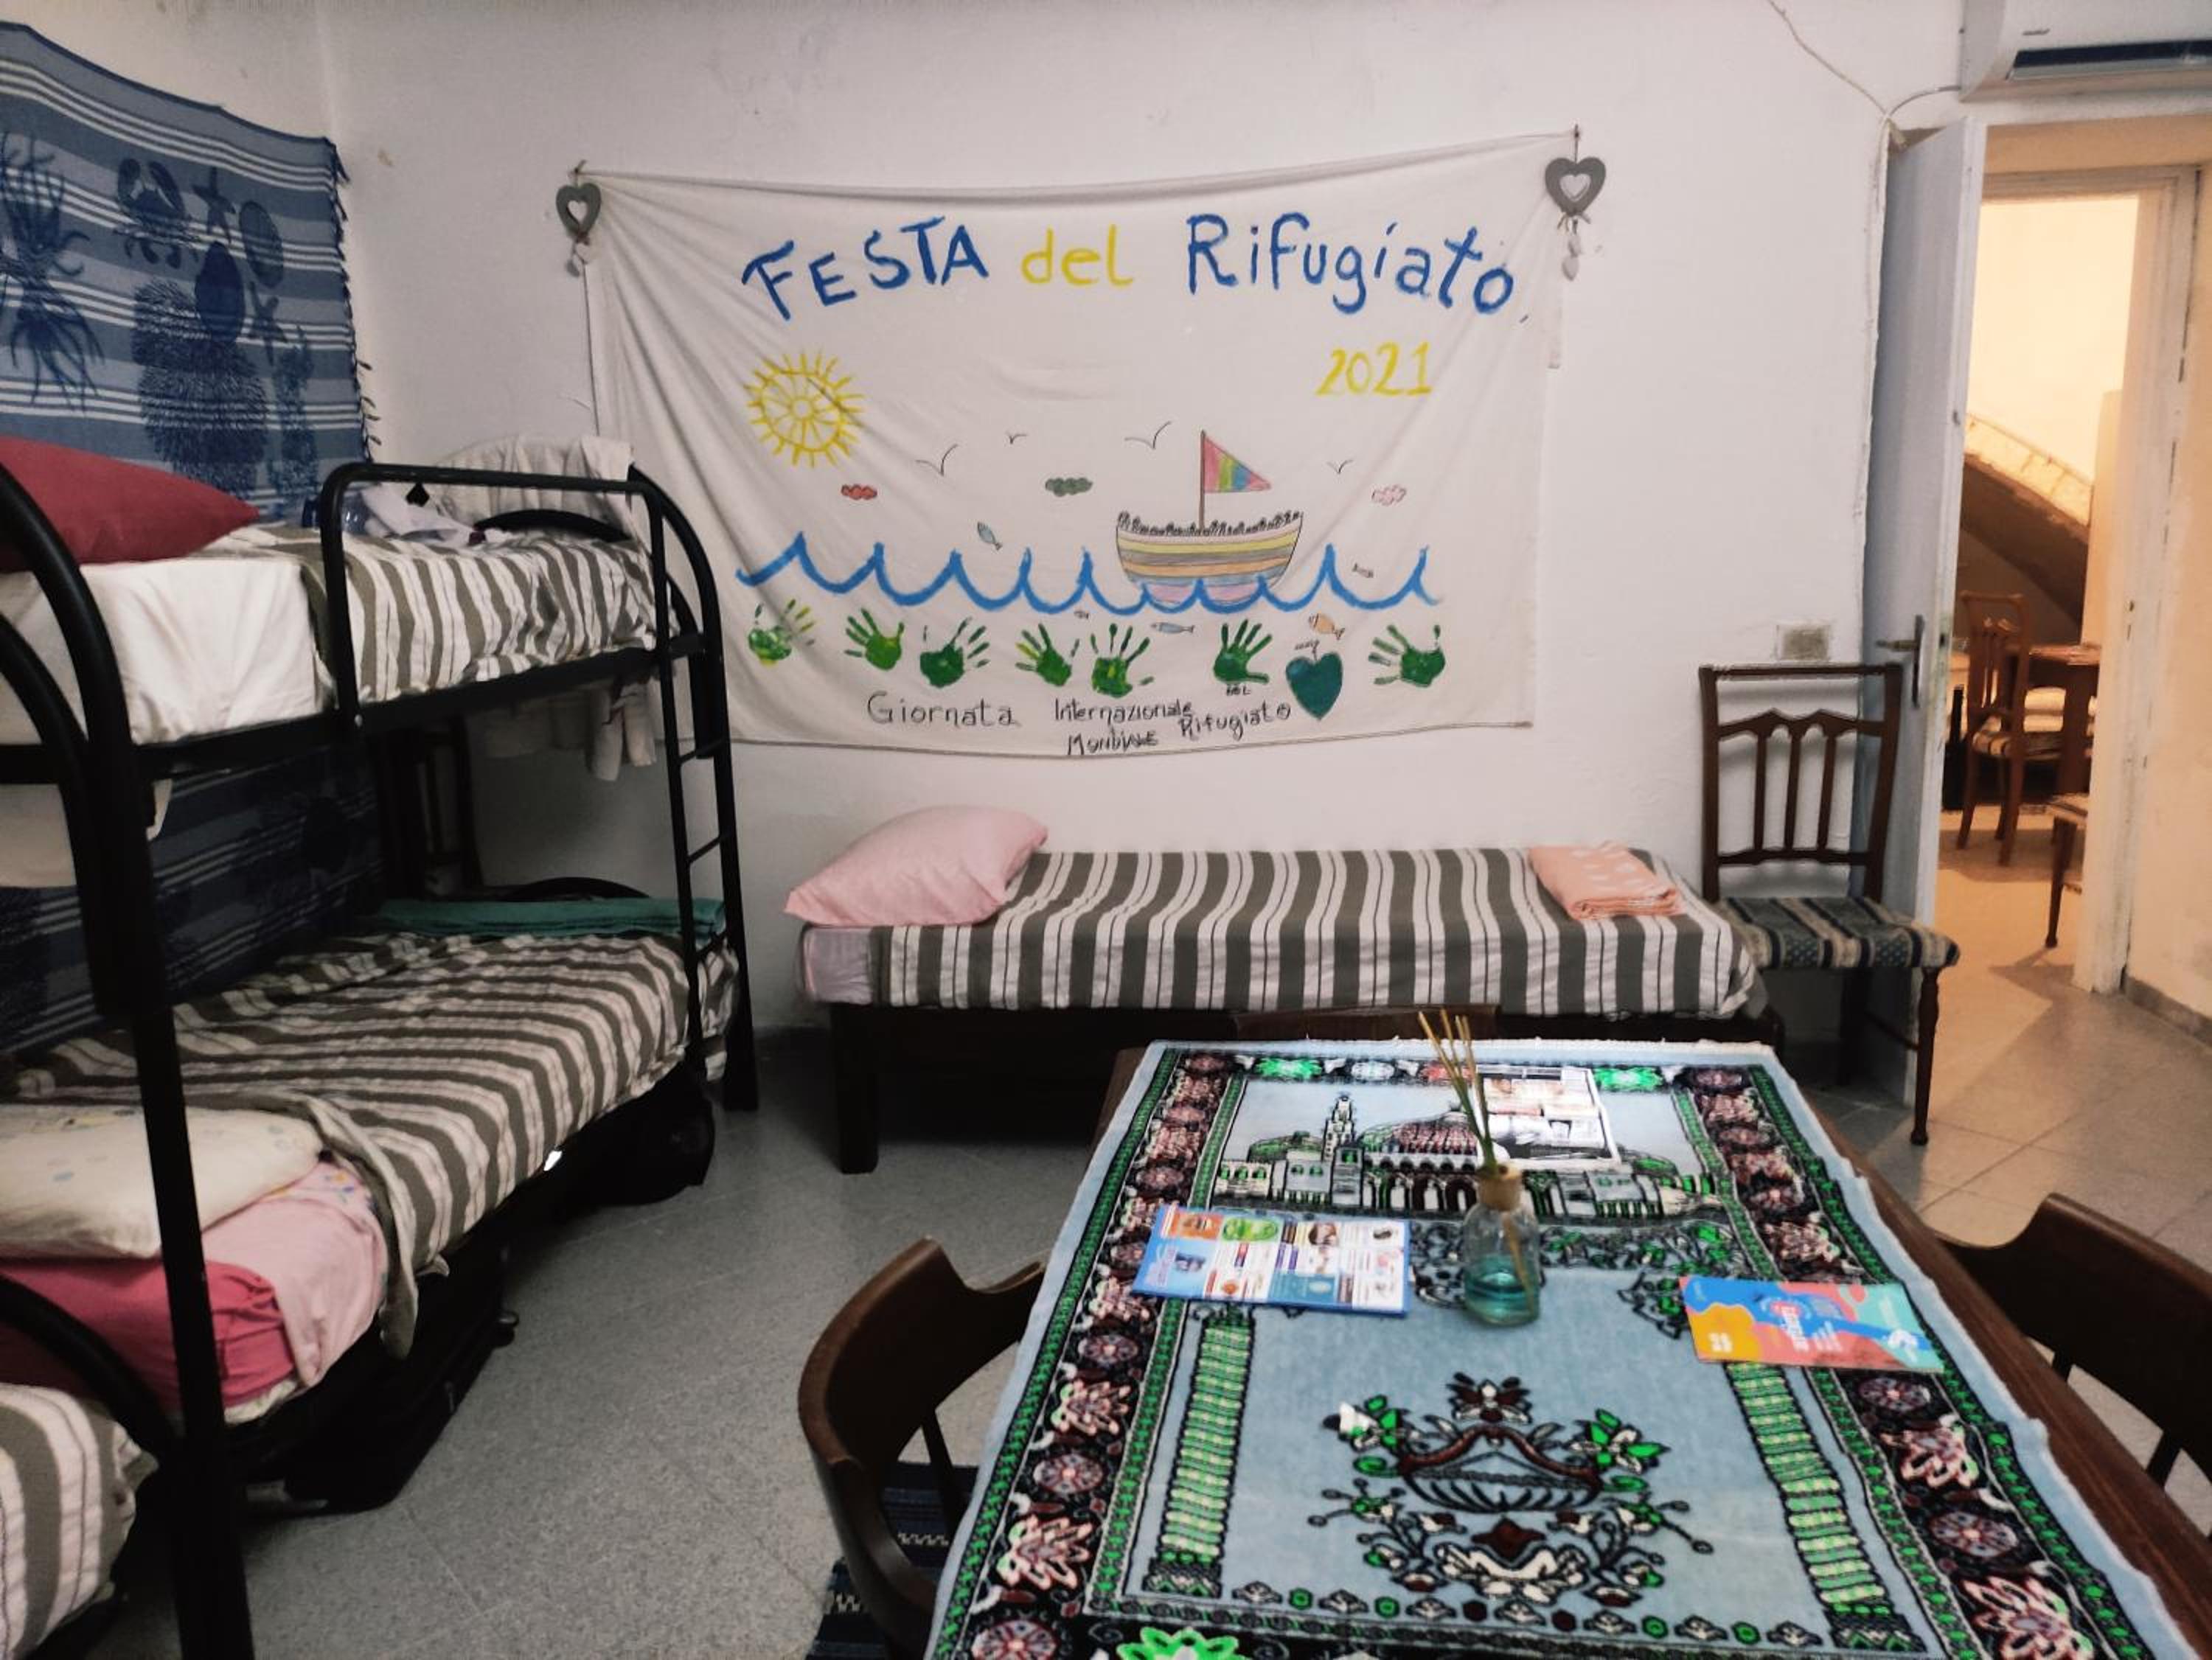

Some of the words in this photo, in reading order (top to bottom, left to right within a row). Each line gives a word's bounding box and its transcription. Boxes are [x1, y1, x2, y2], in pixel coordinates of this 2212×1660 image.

[741, 215, 989, 321] FESTA
[1021, 223, 1134, 288] del
[1186, 212, 1514, 314] Rifugiato
[1315, 342, 1432, 397] 2021
[867, 690, 1023, 728] Giornata
